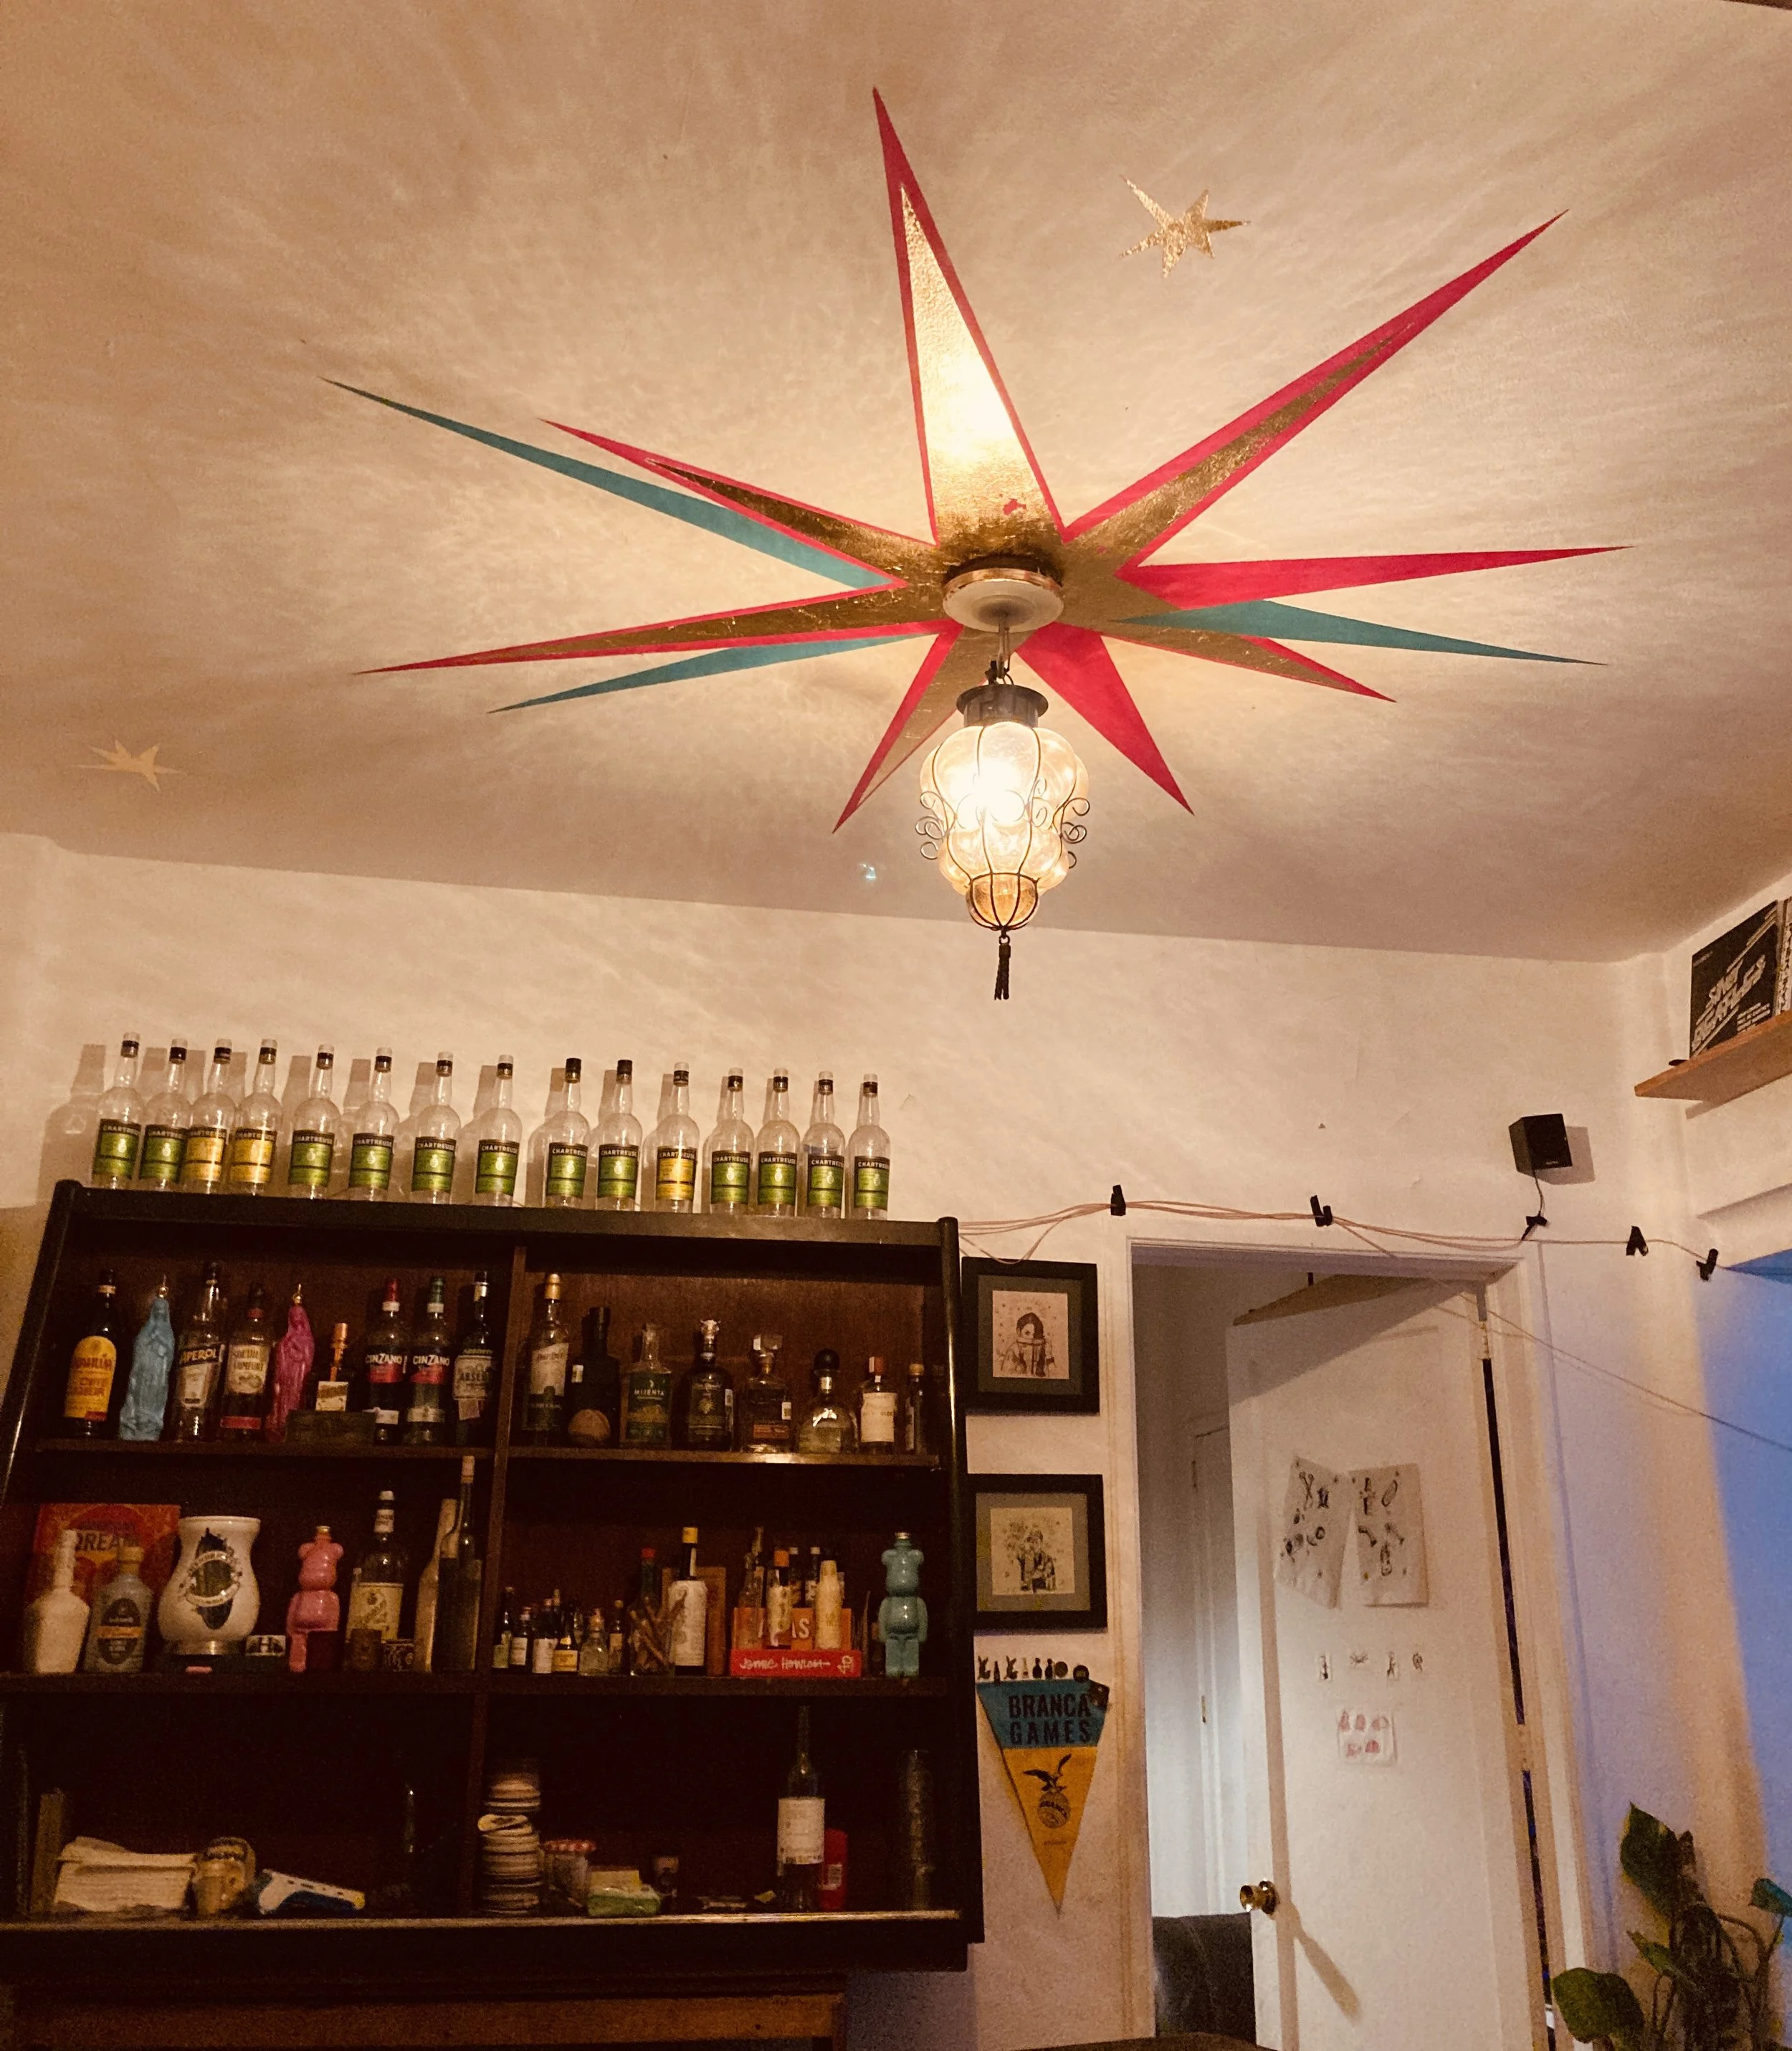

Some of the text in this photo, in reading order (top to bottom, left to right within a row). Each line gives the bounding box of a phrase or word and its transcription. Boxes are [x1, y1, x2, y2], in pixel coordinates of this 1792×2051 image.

[481, 1145, 518, 1153] CHARTREUSE
[552, 1148, 587, 1157] CHARTREUSE
[365, 1353, 403, 1365] CINZANO
[413, 1354, 450, 1366] CINZANO
[1009, 1693, 1091, 1718] BRANCA
[1009, 1721, 1092, 1744] GAMES
